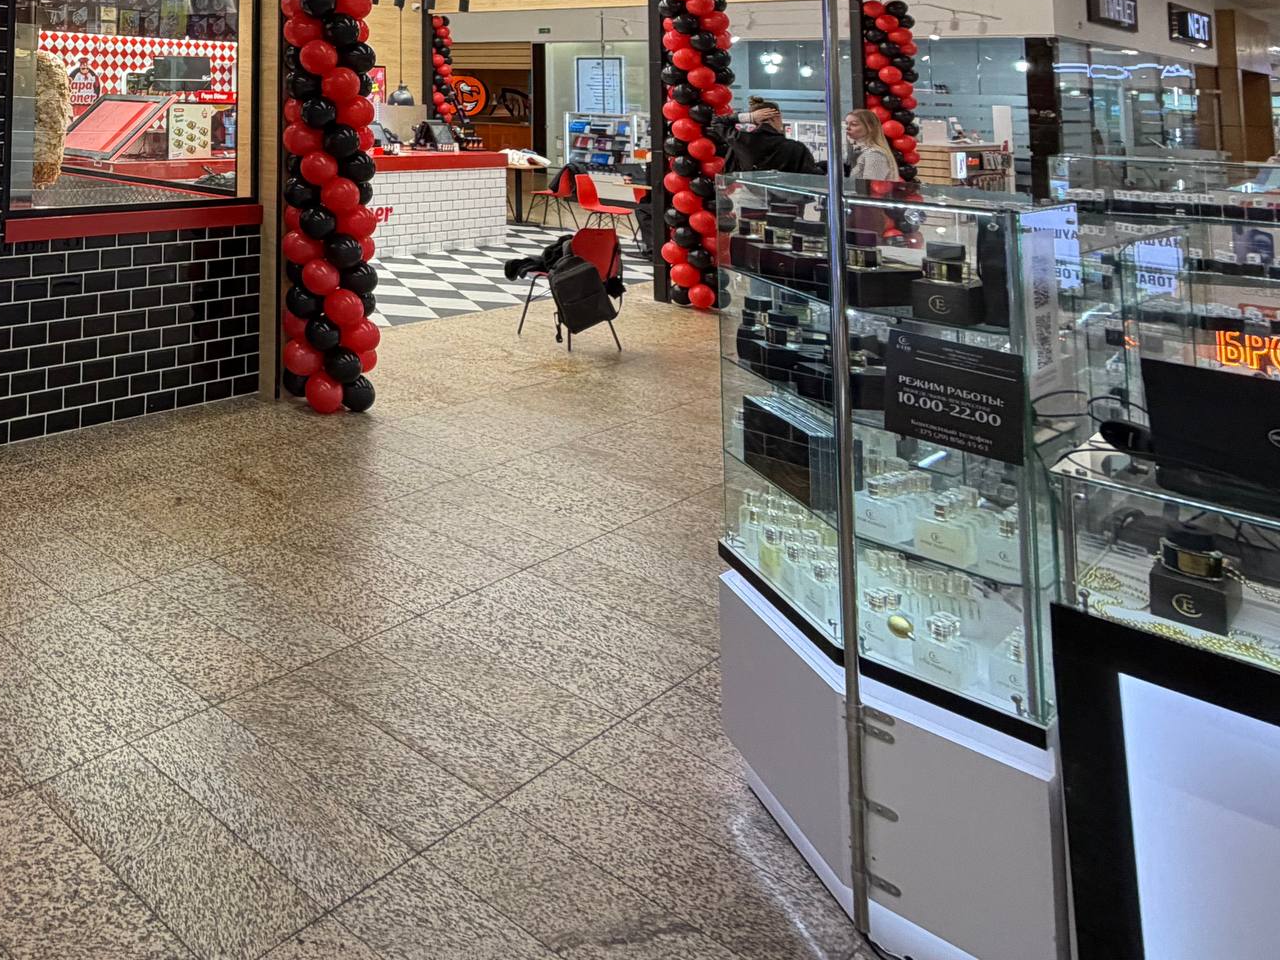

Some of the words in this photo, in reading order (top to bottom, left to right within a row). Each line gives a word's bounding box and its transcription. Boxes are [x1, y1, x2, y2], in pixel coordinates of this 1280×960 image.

[1187, 12, 1210, 42] NEXT
[70, 80, 92, 92] apa
[898, 374, 944, 394] РЕЖИМ
[947, 386, 1005, 408] РАБОТЫ:
[897, 391, 1002, 427] 10.00-22.00
